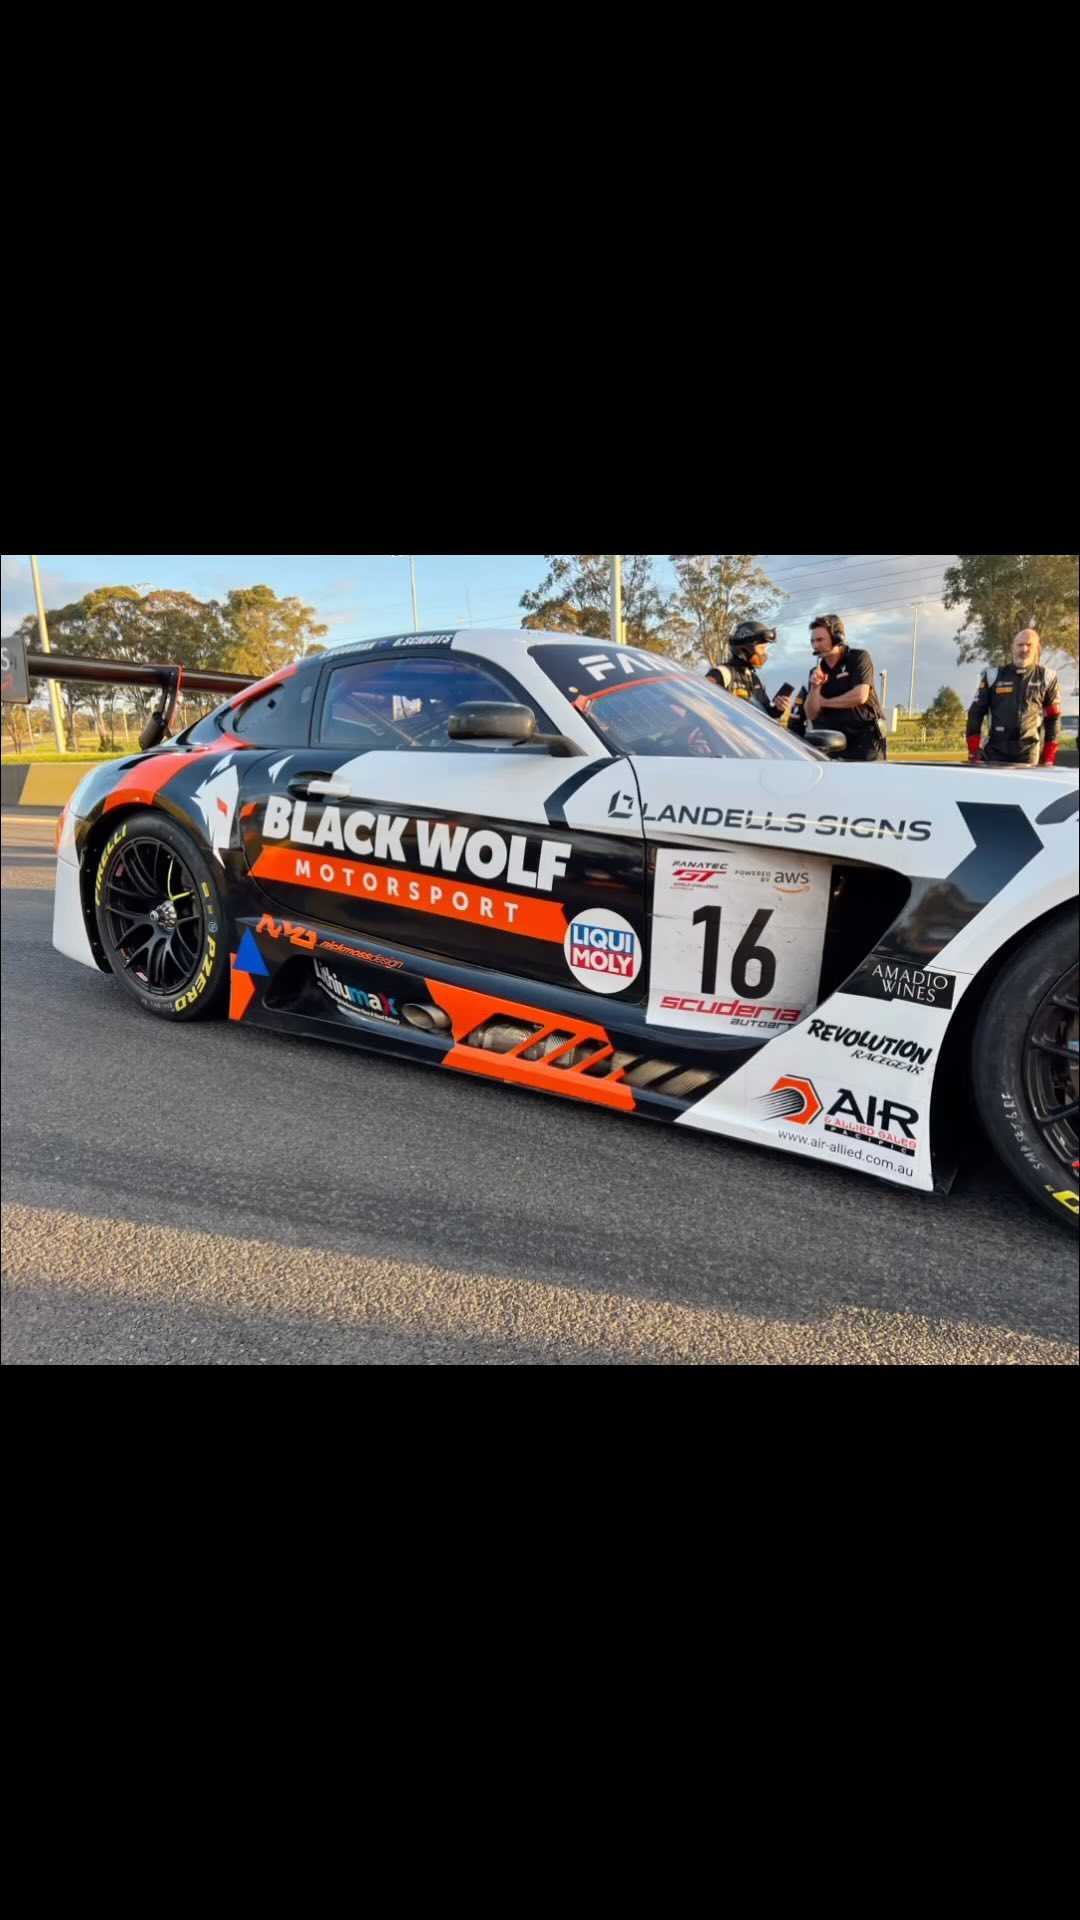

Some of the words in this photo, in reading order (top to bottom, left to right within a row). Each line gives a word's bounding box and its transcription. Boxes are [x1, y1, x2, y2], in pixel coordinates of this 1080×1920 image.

[642, 803, 806, 833] LANDELLS
[815, 815, 932, 841] SIGNS
[262, 795, 410, 862] BLACK
[416, 819, 572, 892] WOLF
[95, 824, 127, 906] PIRELLI
[672, 860, 728, 870] FANATEC
[774, 870, 809, 885] aws
[295, 859, 519, 923] MOTORSPORT
[572, 925, 632, 953] LIQUI
[692, 904, 776, 1000] 16
[572, 947, 632, 975] MOLY
[872, 964, 948, 990] AMADIO
[882, 979, 936, 1002] WINES
[660, 996, 803, 1021] scuderia
[807, 1019, 933, 1065] REVOLUTION
[850, 1050, 925, 1075] RACEGEAR
[826, 1088, 920, 1140] AIR
[830, 1126, 908, 1155] PACIFIC
[834, 1119, 875, 1136] ALLIED
[878, 1131, 917, 1149] SALES
[777, 1128, 914, 1178] www.air-allied.com.au
